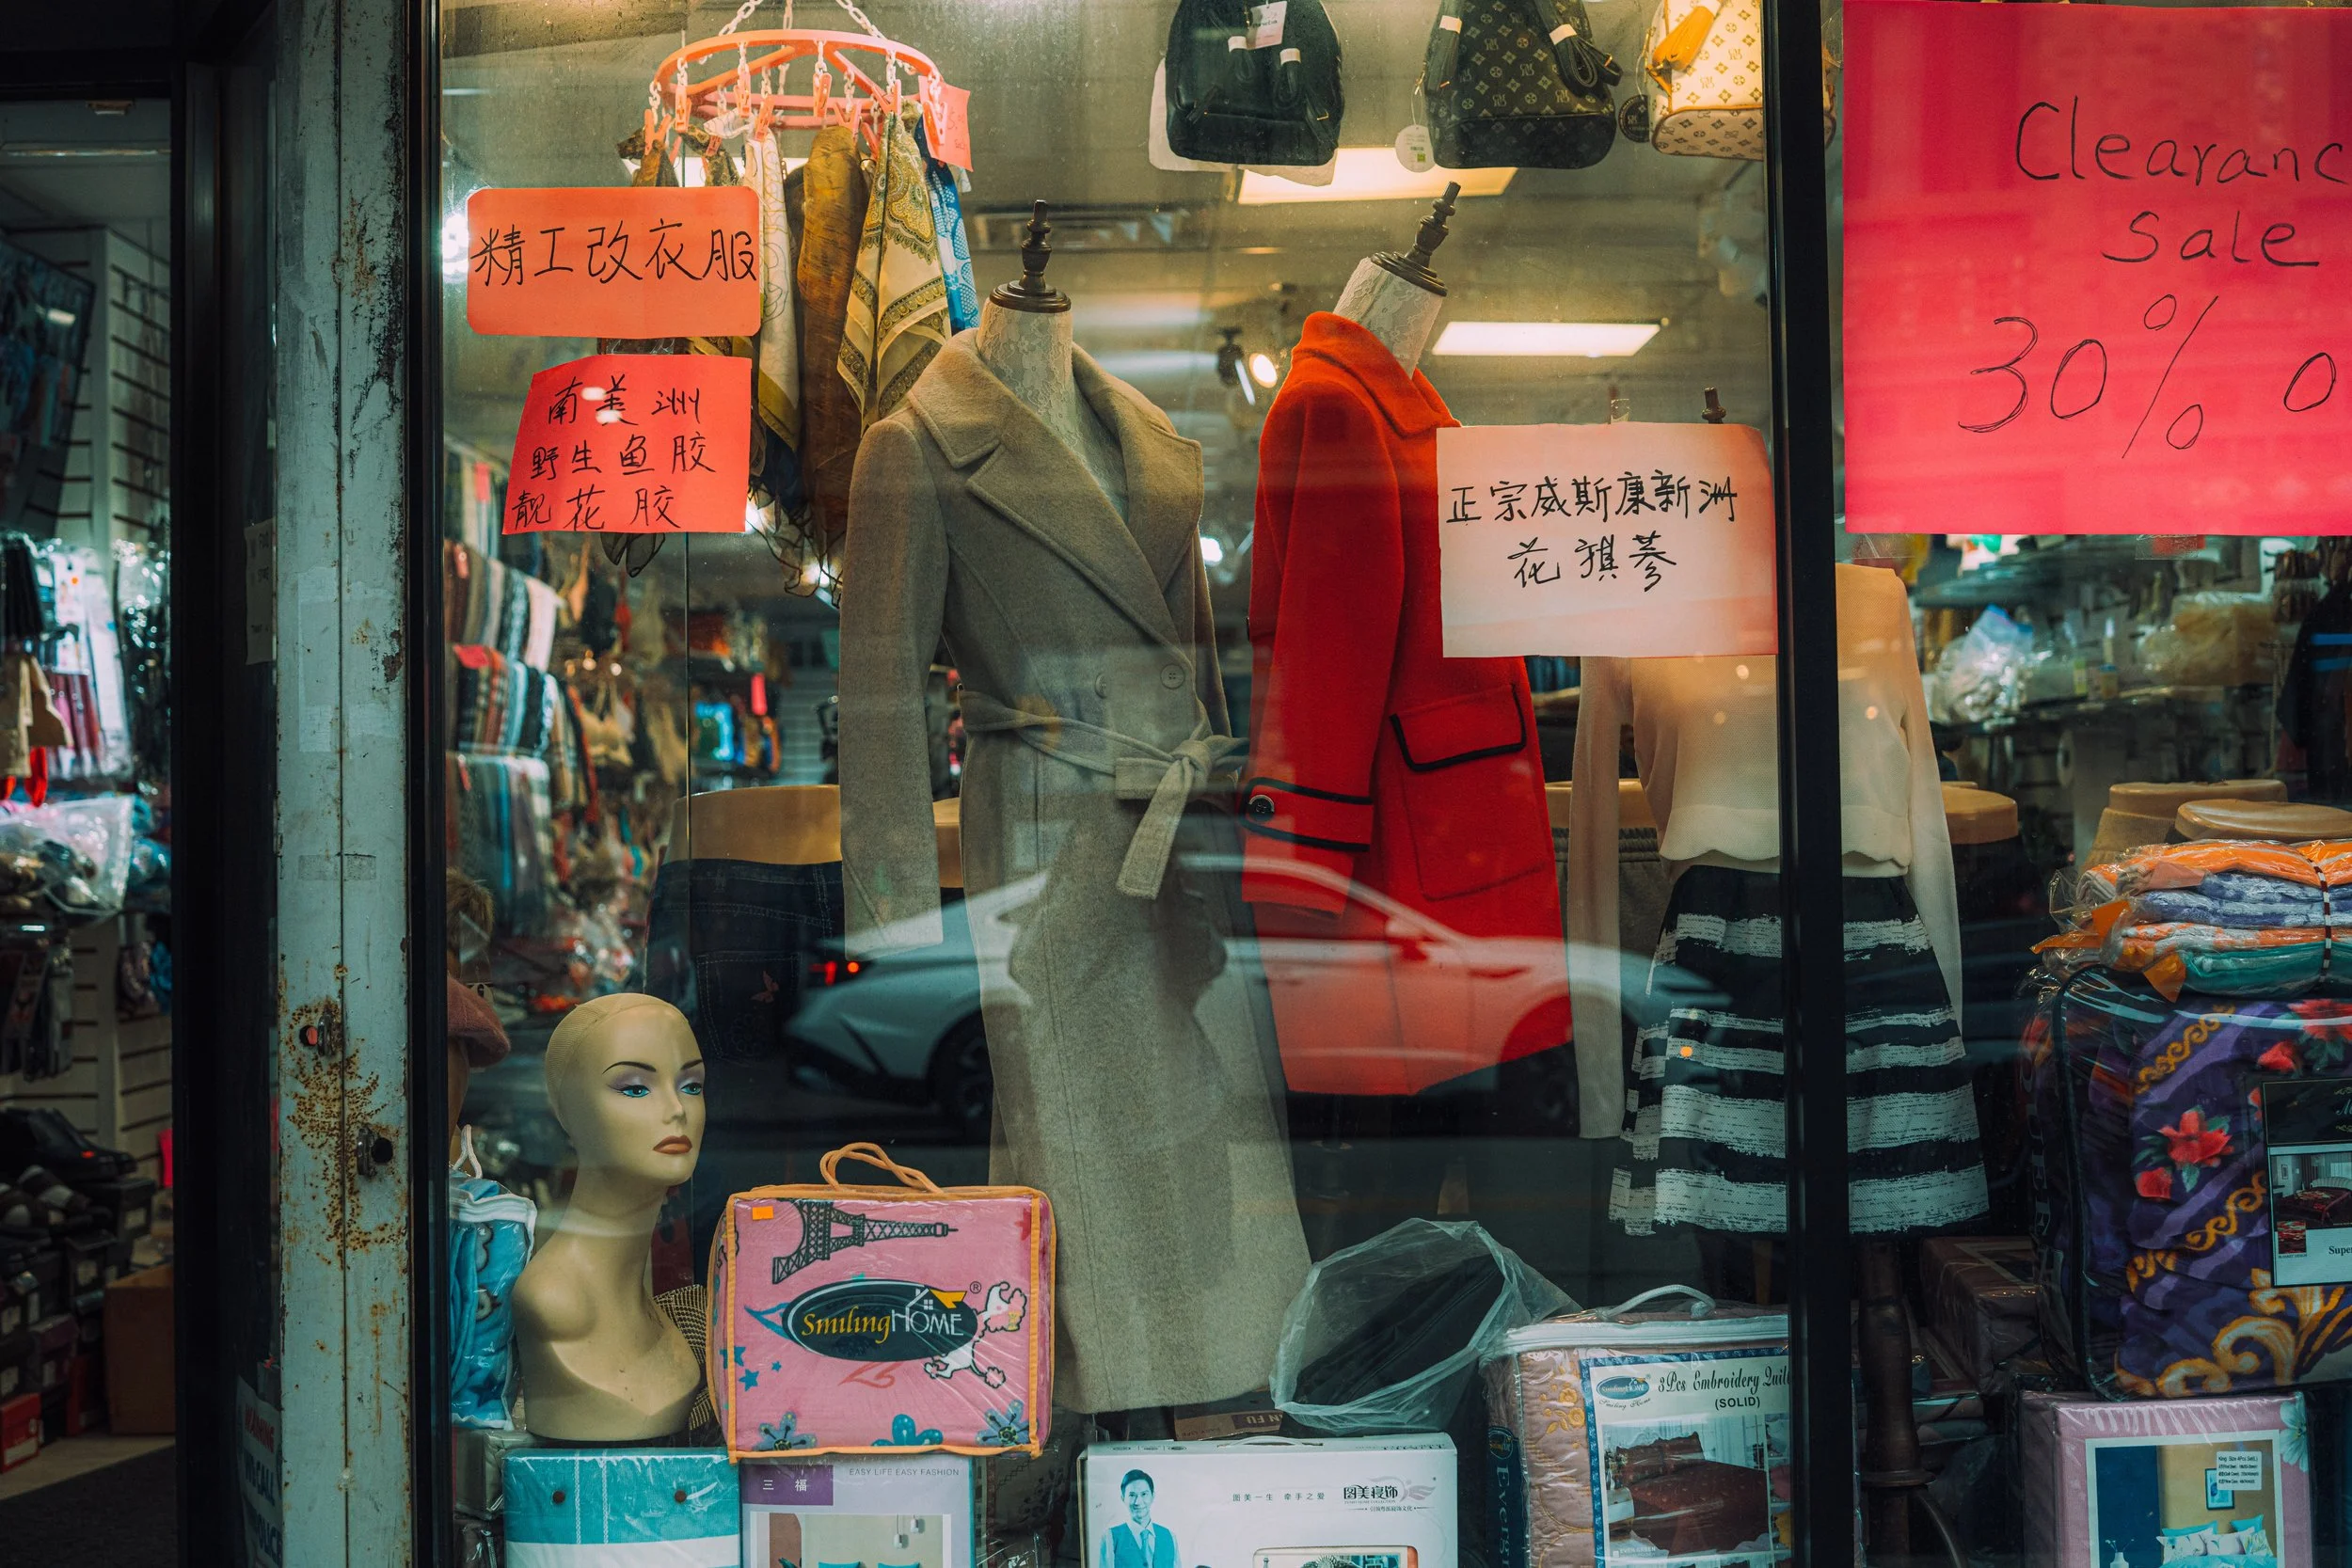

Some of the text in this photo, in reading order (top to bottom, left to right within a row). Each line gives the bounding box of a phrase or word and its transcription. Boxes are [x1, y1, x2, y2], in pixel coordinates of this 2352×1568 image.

[2015, 95, 2349, 185] Clearanc
[469, 219, 757, 286] 精工改衣服
[548, 373, 702, 426] 南美洲
[1957, 293, 2219, 460] 30%
[531, 430, 717, 482] 野生鱼胶
[511, 484, 682, 531] 靓花胶
[1692, 1368, 1760, 1395] Embroidery
[1714, 1396, 1761, 1411] (SOLID)
[762, 1479, 808, 1492] 三福
